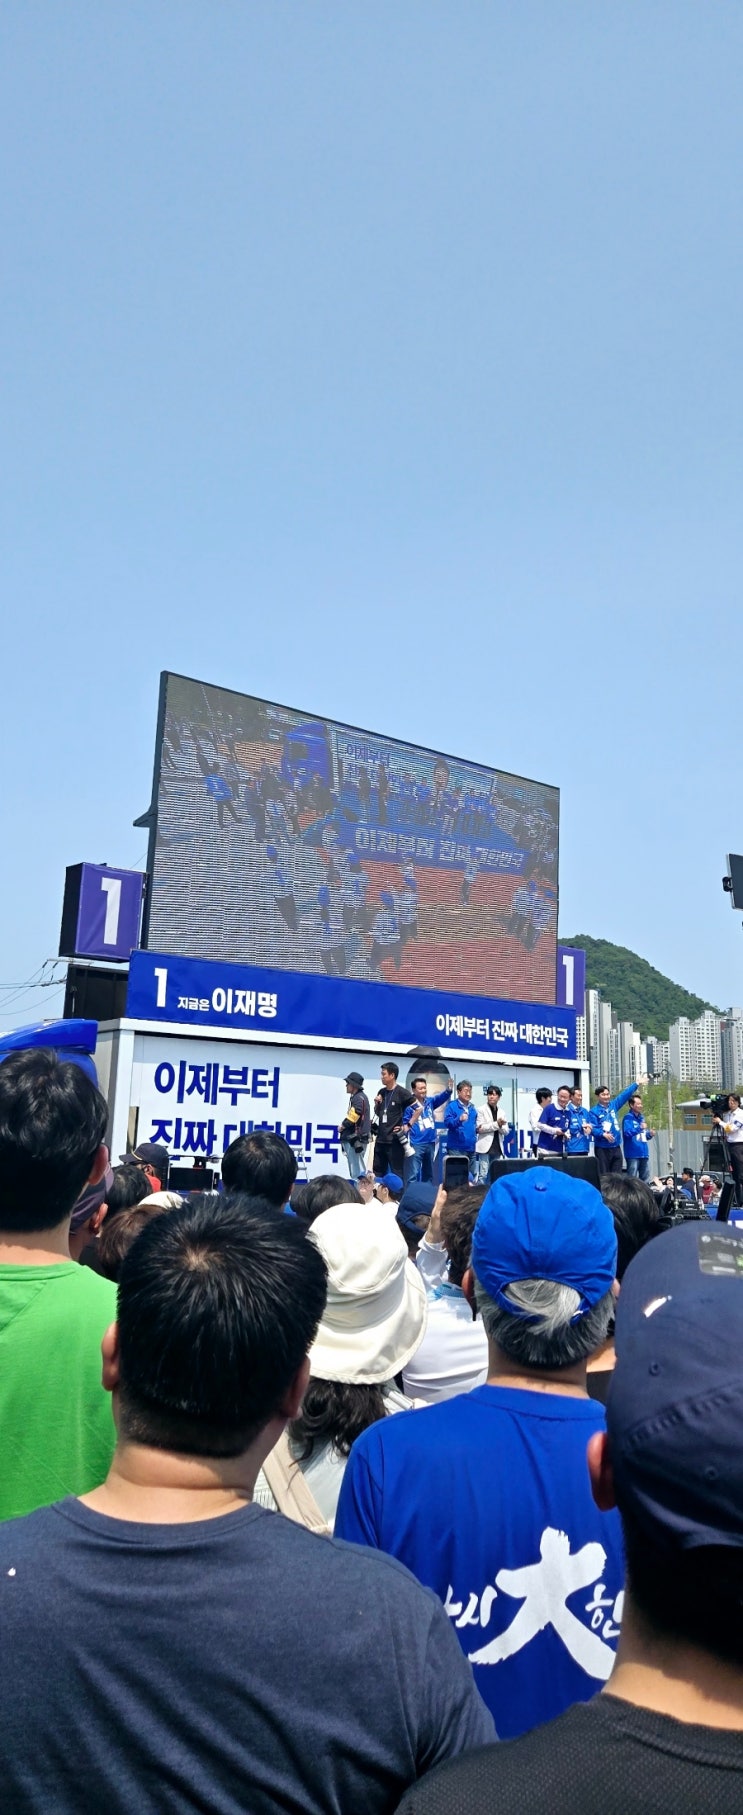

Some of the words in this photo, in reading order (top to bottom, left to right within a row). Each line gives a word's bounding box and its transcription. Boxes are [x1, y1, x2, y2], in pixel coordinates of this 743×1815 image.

[101, 877, 122, 945] 1
[154, 967, 168, 1008] 1
[177, 996, 210, 1012] 지금은
[211, 987, 278, 1018] 이재명
[562, 955, 575, 1006] 1
[435, 1013, 490, 1040] 이제부터
[492, 1020, 519, 1043] 진짜
[519, 1023, 569, 1048] 대한민국
[154, 1060, 280, 1108] 이제부터
[149, 1118, 218, 1161] 진짜
[223, 1120, 341, 1164] 대민국
